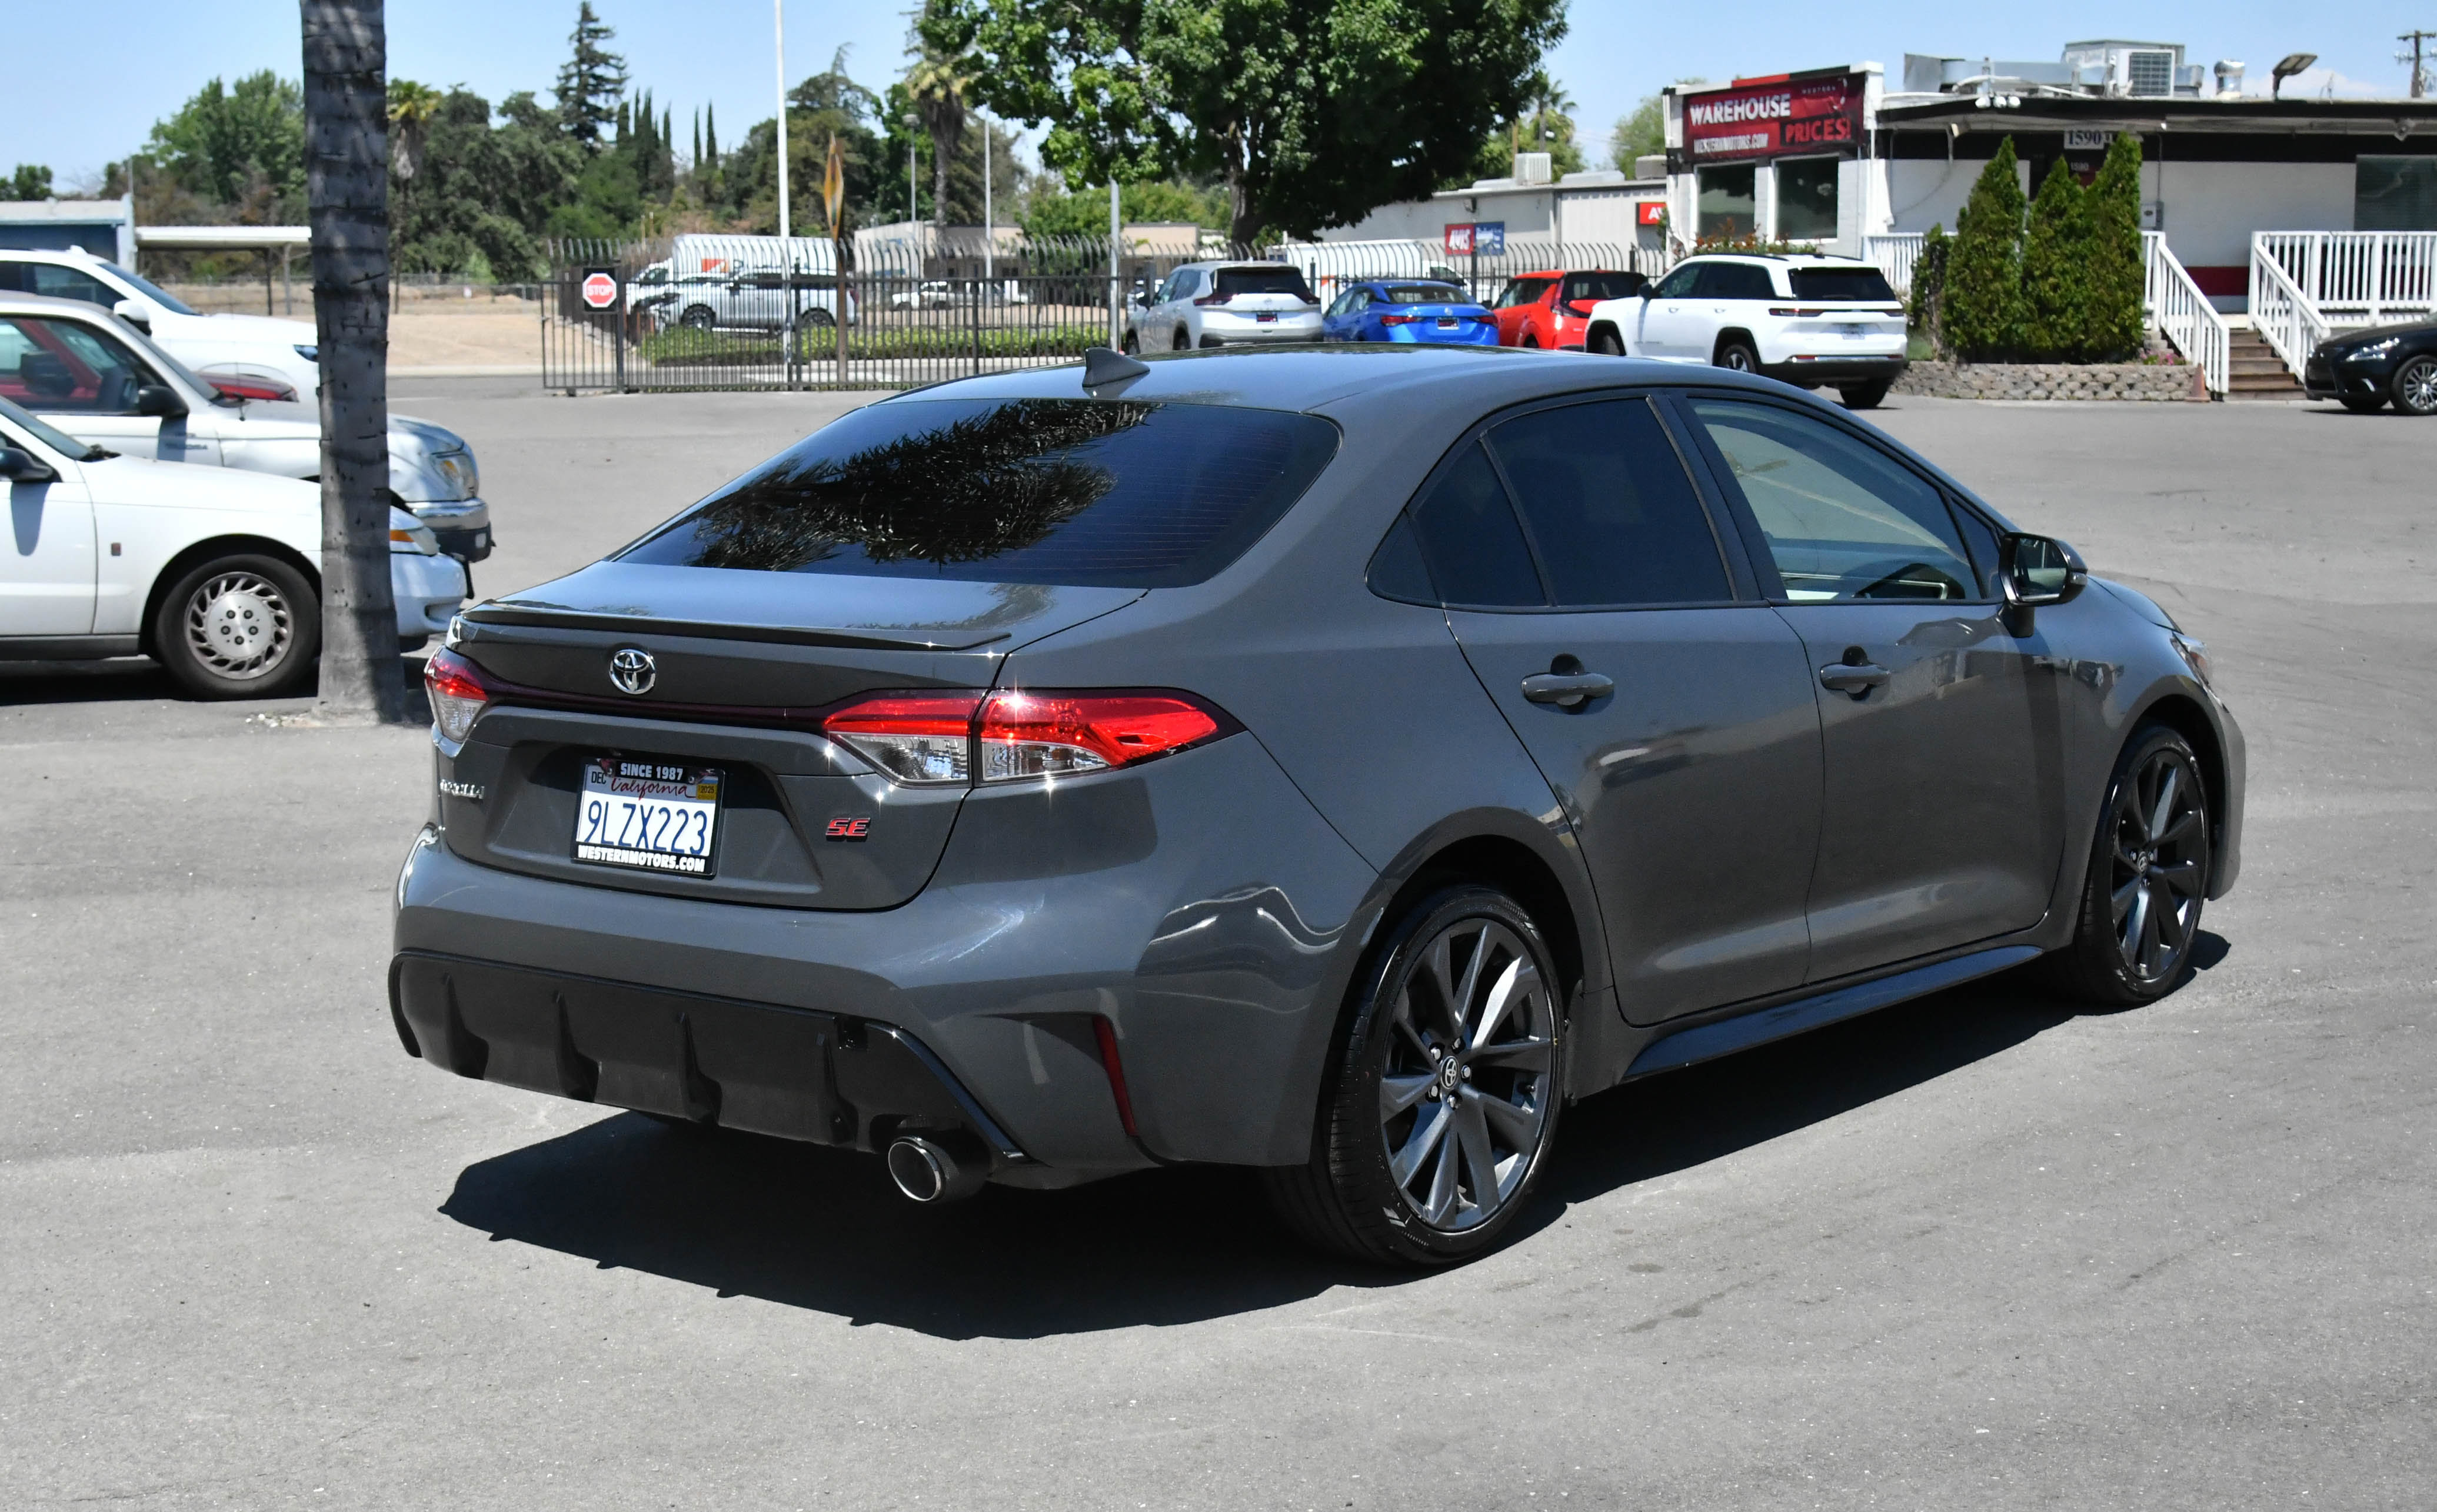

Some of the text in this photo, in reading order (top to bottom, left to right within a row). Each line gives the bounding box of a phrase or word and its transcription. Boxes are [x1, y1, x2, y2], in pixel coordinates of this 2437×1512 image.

[1690, 93, 1791, 126] WAREHOUSE
[1785, 118, 1852, 143] PRICES!
[2068, 130, 2102, 145] 1590
[1448, 228, 1471, 250] AVIS
[587, 285, 613, 297] STOP
[591, 771, 607, 785] DEC
[620, 762, 684, 780] SINCE 1987
[611, 777, 697, 801] California
[584, 800, 707, 855] 9LZX223
[825, 817, 870, 838] SE
[578, 845, 705, 872] WESTERNMOTORS.COM
